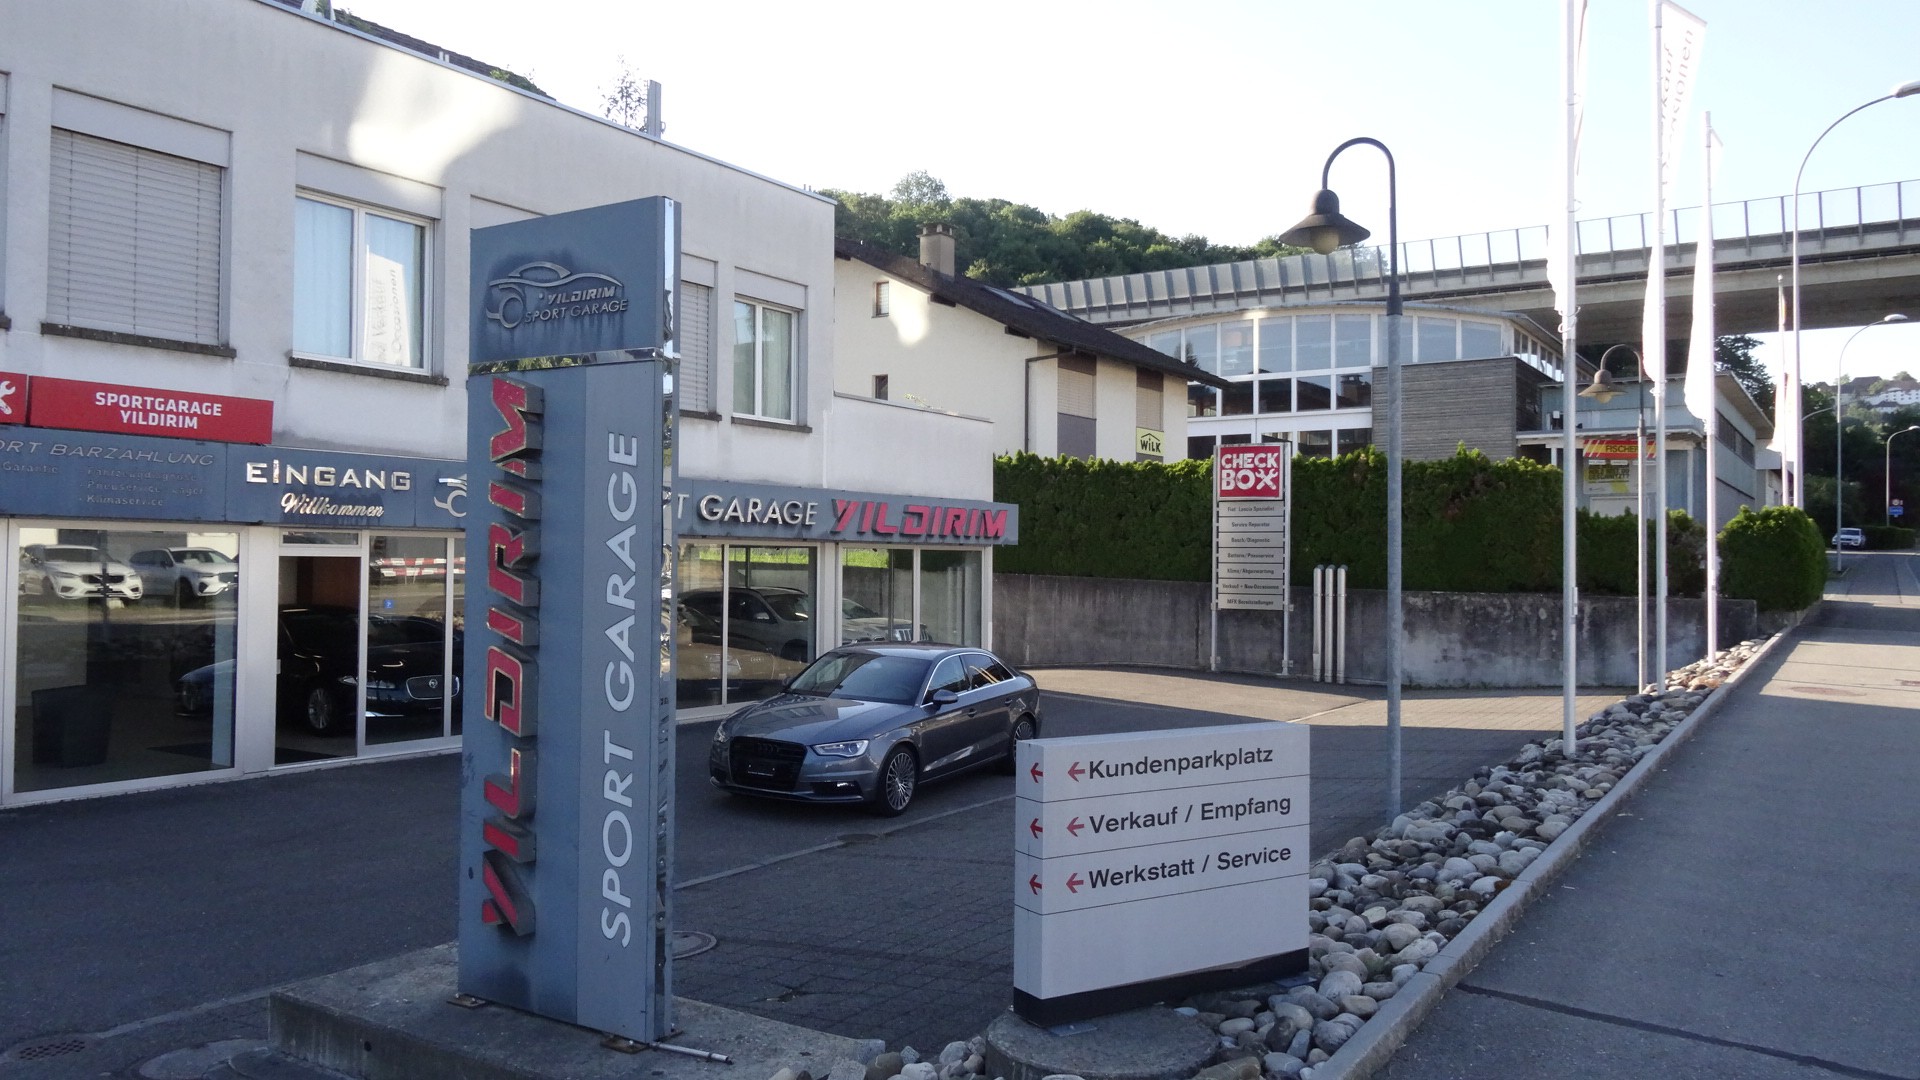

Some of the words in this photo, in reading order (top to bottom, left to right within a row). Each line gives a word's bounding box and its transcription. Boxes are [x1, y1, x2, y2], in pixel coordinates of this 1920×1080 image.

[547, 286, 616, 304] YILDIRIM
[524, 307, 566, 323] SPORT
[570, 299, 628, 318] GARAGE
[95, 391, 223, 416] SPORTGARAGE
[120, 410, 198, 429] YILDIRIM
[50, 444, 214, 466] BARZAHLUNG
[1221, 452, 1279, 469] CHECK
[246, 458, 412, 491] EINGANG
[1221, 468, 1279, 491] BOX
[281, 492, 386, 518] Willkommen
[699, 494, 819, 526] GARAGE
[831, 498, 1008, 538] YILDIRIM
[604, 431, 638, 713] GARAGE
[482, 378, 536, 934] YILDIRIM
[1089, 747, 1273, 779] Kundenparkplatz
[1089, 806, 1179, 834] Verkauf
[1184, 804, 1194, 823] /
[1200, 797, 1291, 820] Empfang
[600, 728, 635, 949] SPORT
[1089, 858, 1195, 889] Werkstatt
[1201, 854, 1210, 873] /
[1217, 847, 1292, 871] Service
